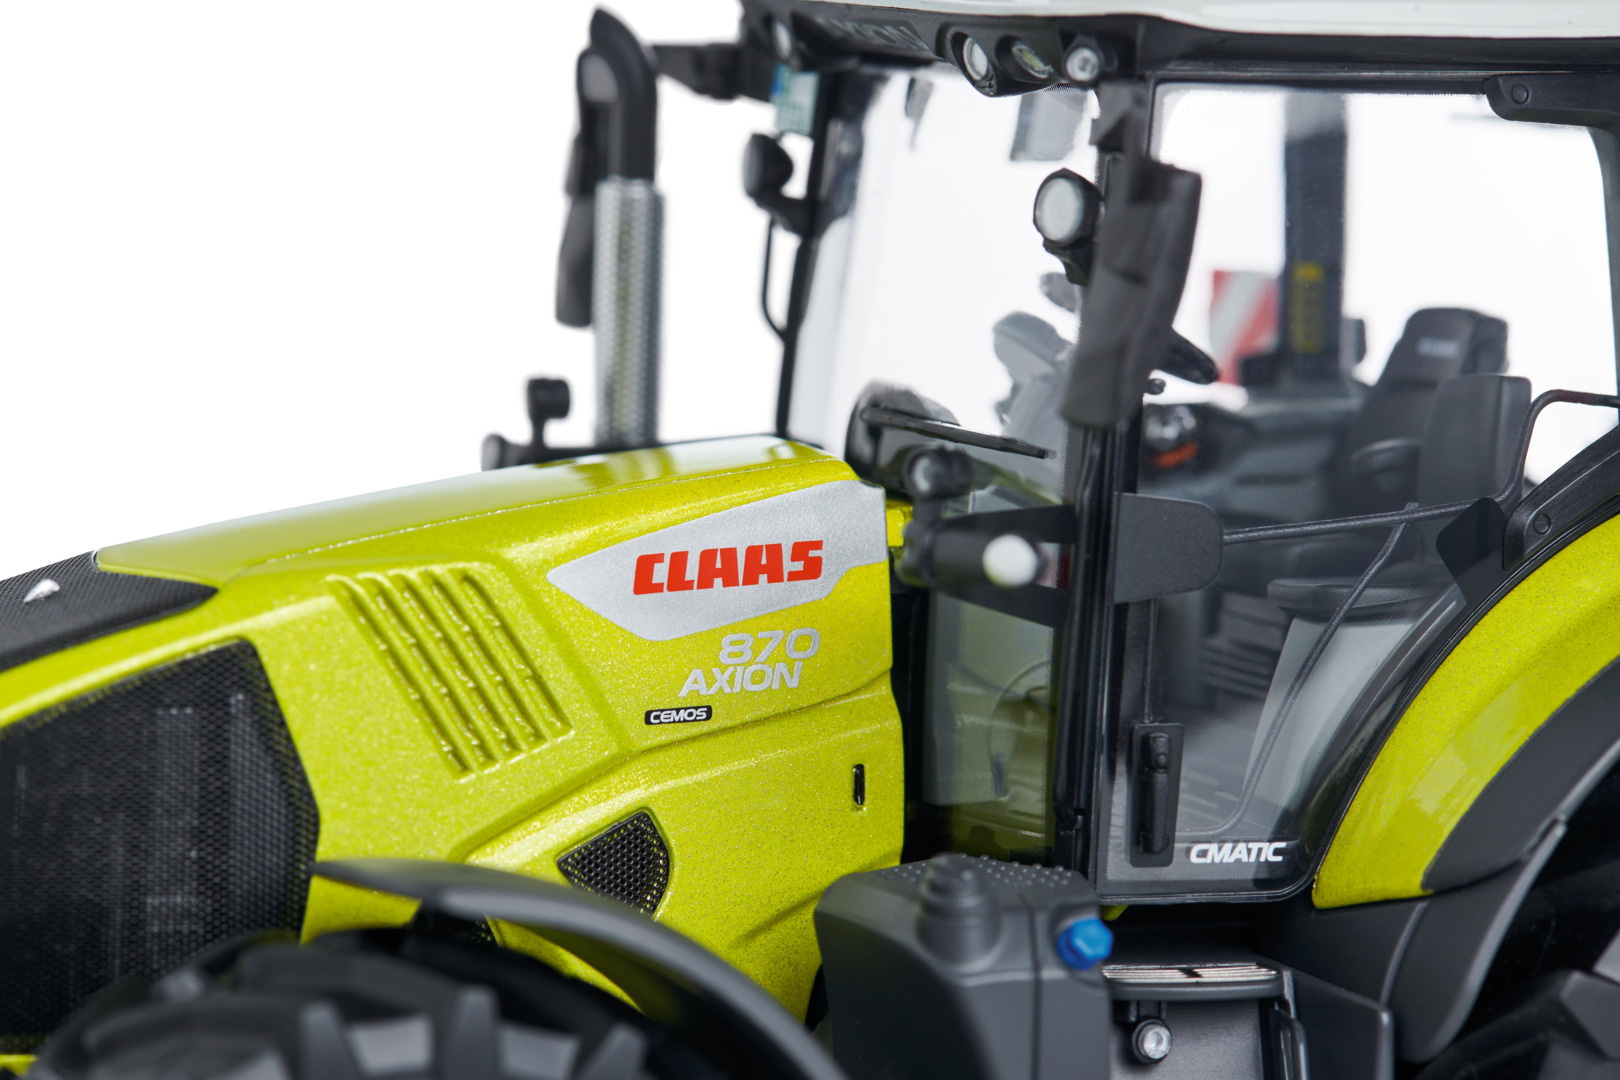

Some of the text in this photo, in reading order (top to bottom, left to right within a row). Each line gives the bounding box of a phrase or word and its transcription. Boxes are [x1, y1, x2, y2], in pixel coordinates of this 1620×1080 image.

[633, 540, 823, 595] CLAAS
[720, 627, 821, 665] 870
[678, 661, 803, 697] AXION
[649, 707, 708, 724] CEMOS
[1190, 841, 1287, 864] CMATIC
